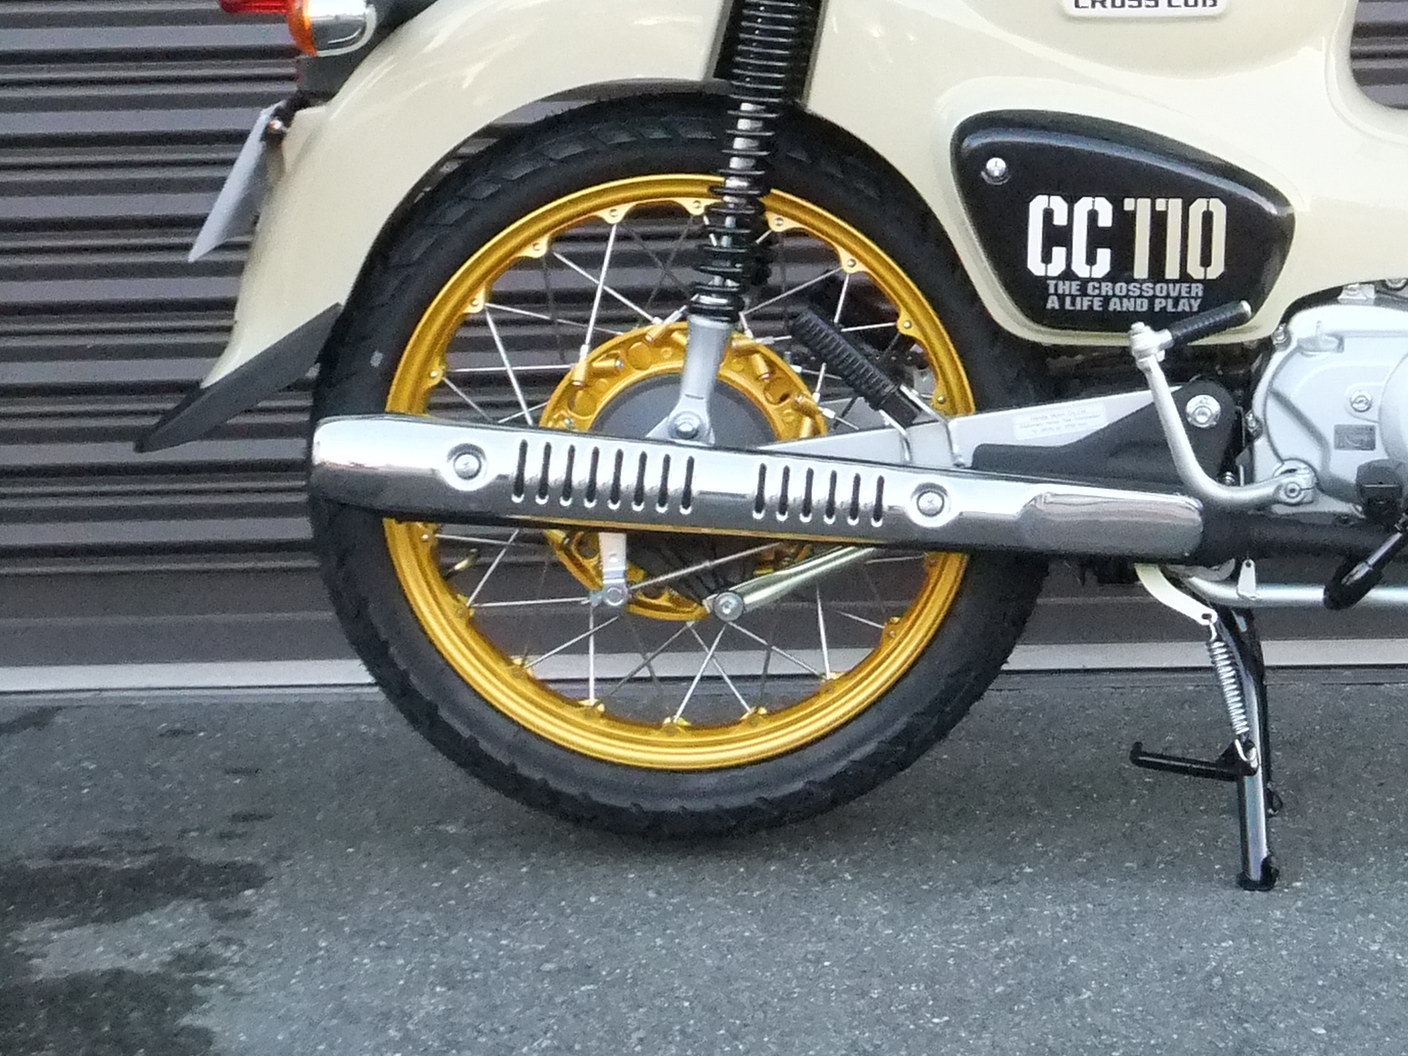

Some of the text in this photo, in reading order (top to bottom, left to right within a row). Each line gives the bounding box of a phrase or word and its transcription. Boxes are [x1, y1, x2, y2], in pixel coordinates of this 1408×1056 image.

[1047, 280, 1204, 297] THE CROSSOVER
[1046, 296, 1203, 313] A LIFE AND PLAY
